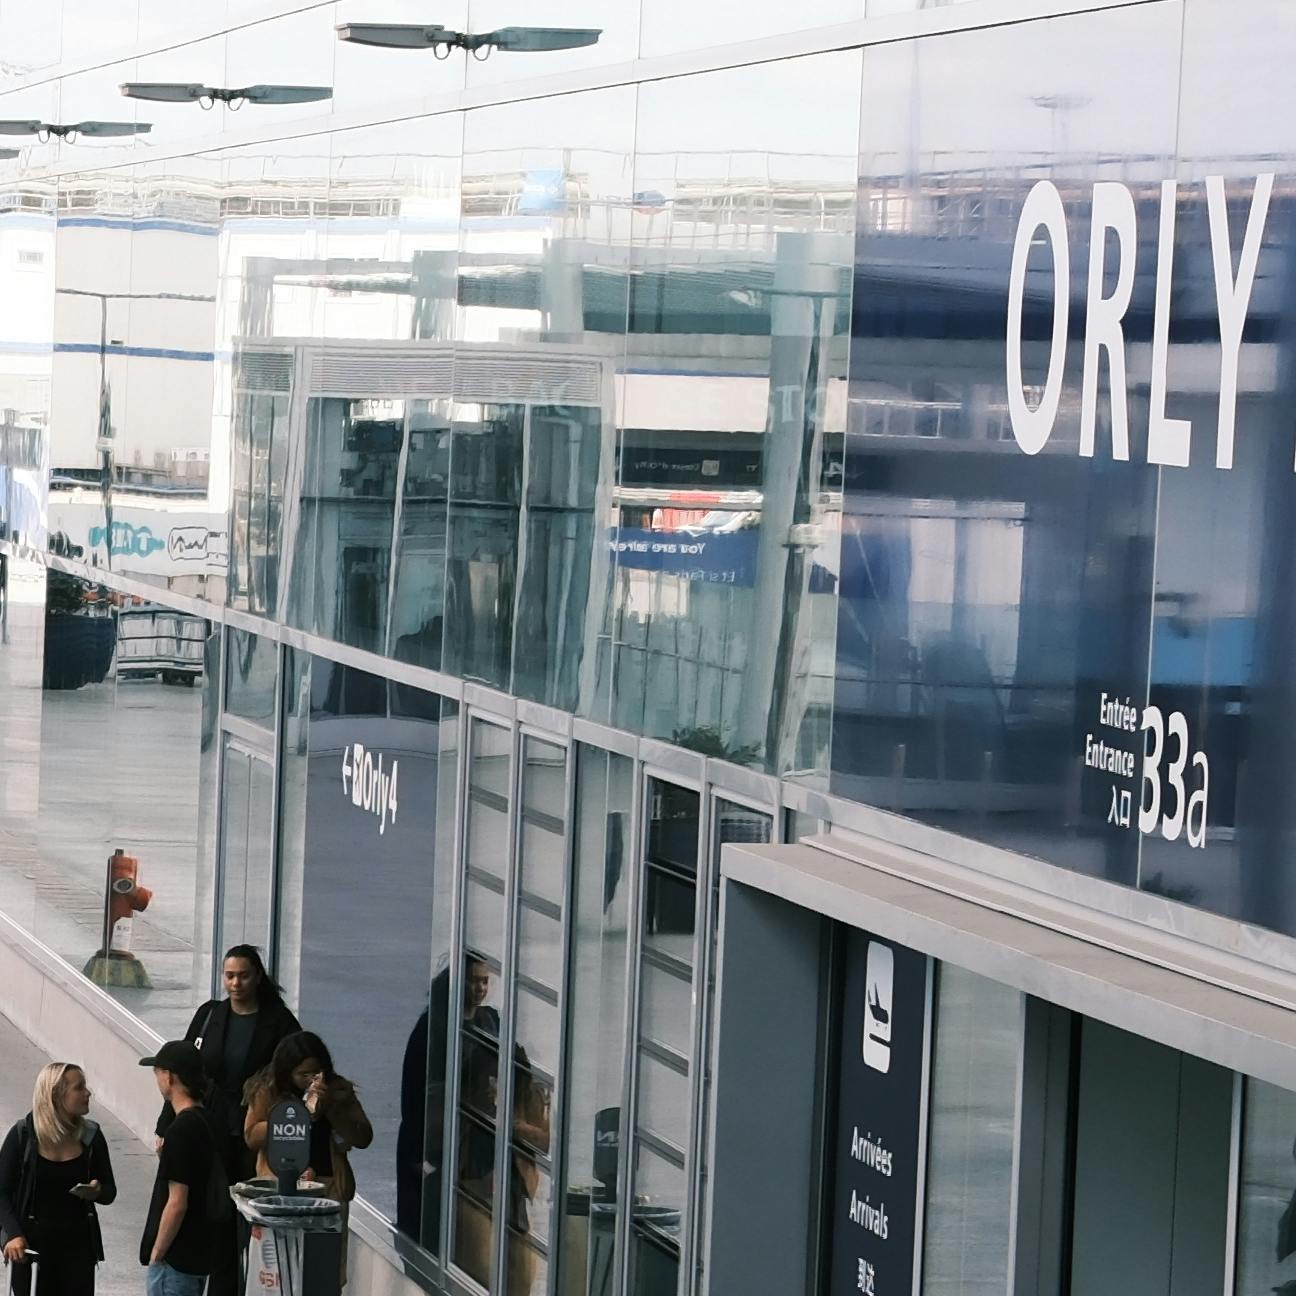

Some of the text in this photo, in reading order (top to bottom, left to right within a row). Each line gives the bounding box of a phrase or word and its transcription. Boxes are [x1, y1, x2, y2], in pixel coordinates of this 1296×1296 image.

[1006, 173, 1275, 470] ORLY
[1100, 692, 1137, 733] Entrée
[1085, 733, 1135, 778] Entrance
[1138, 705, 1209, 849] 33a
[362, 752, 398, 835] Orly 4
[1107, 784, 1132, 828] 入口
[273, 1123, 306, 1136] NON
[850, 1126, 893, 1177] Arrivées
[848, 1189, 889, 1240] Arrivals
